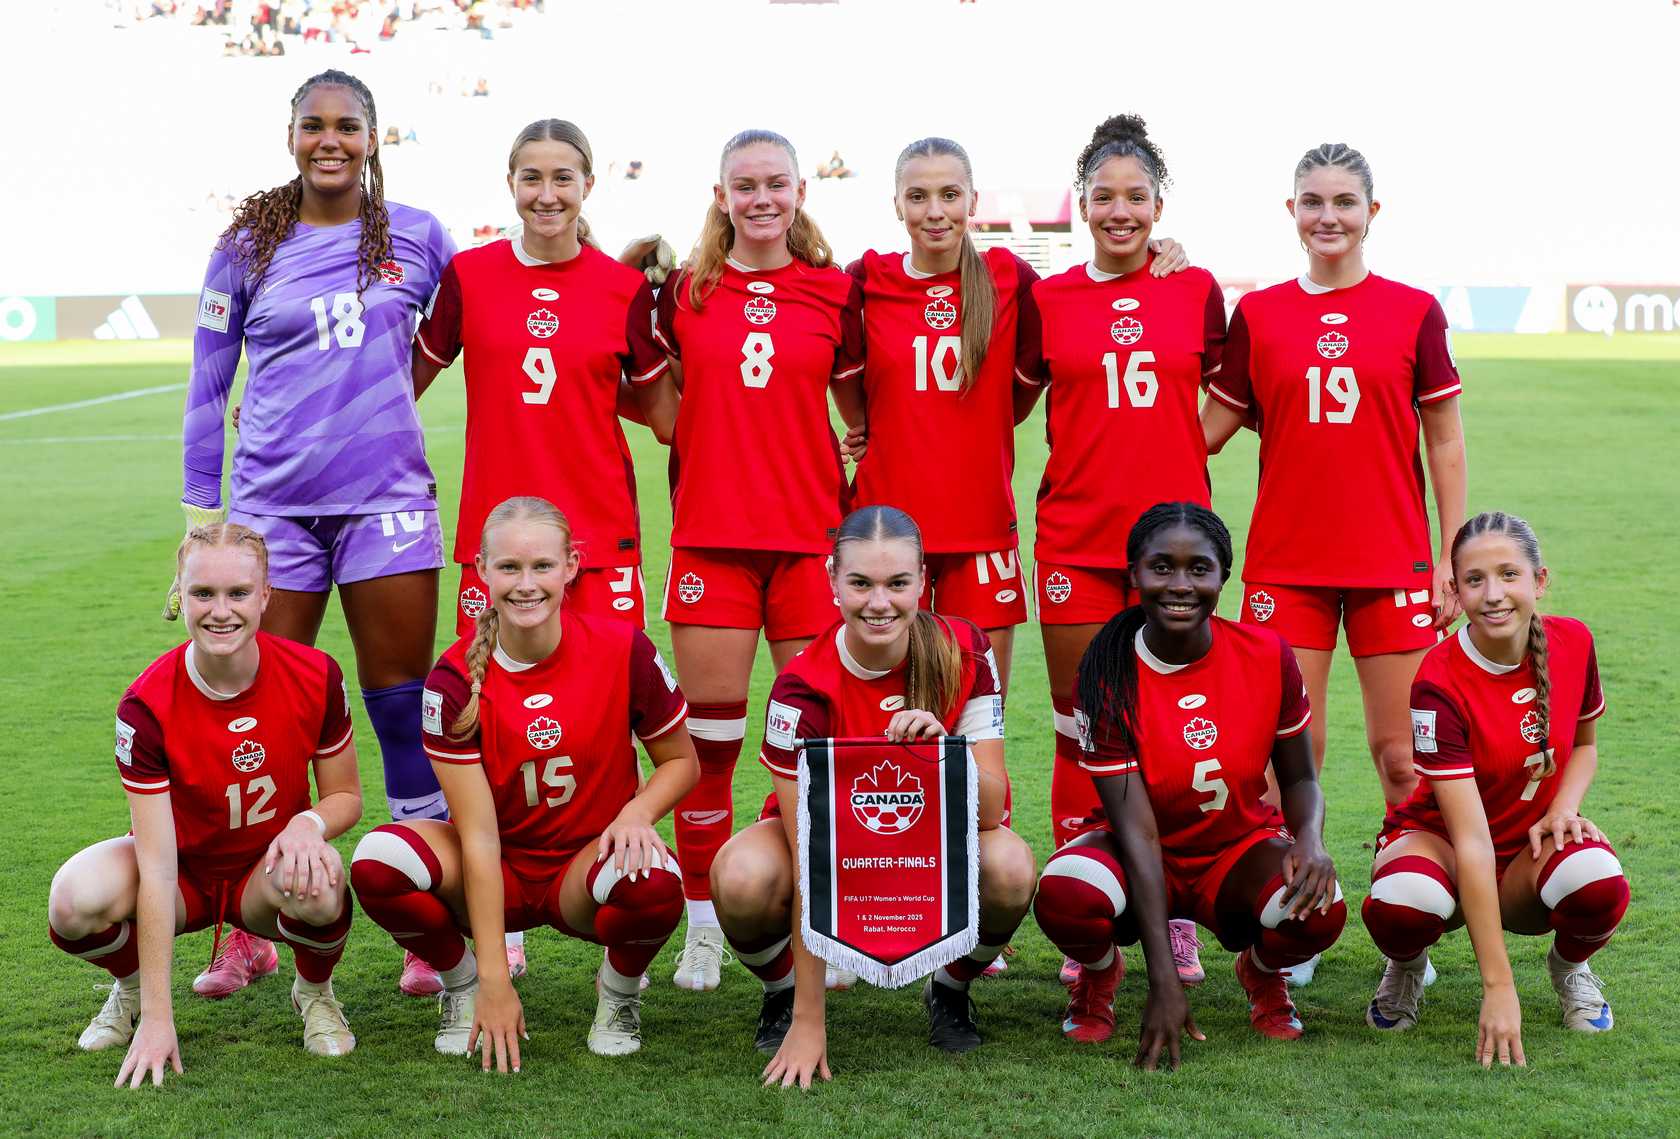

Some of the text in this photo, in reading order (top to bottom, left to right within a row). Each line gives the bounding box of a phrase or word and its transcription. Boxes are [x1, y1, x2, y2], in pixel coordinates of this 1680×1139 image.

[310, 292, 367, 351] 18
[529, 319, 557, 327] CANADA
[745, 307, 774, 315] CANADA
[521, 347, 557, 404] 9
[740, 332, 775, 388] 8
[911, 335, 964, 391] 10
[1101, 350, 1159, 408] 16
[1305, 366, 1361, 424] 19
[233, 751, 263, 763] CANADA
[528, 729, 560, 738] CANADA
[1185, 728, 1216, 739] CANADA
[225, 774, 277, 830] 12
[519, 755, 577, 808] 15
[851, 794, 924, 805] CANADA
[1191, 757, 1230, 813] 5
[842, 857, 936, 869] QUARTER-FINALS
